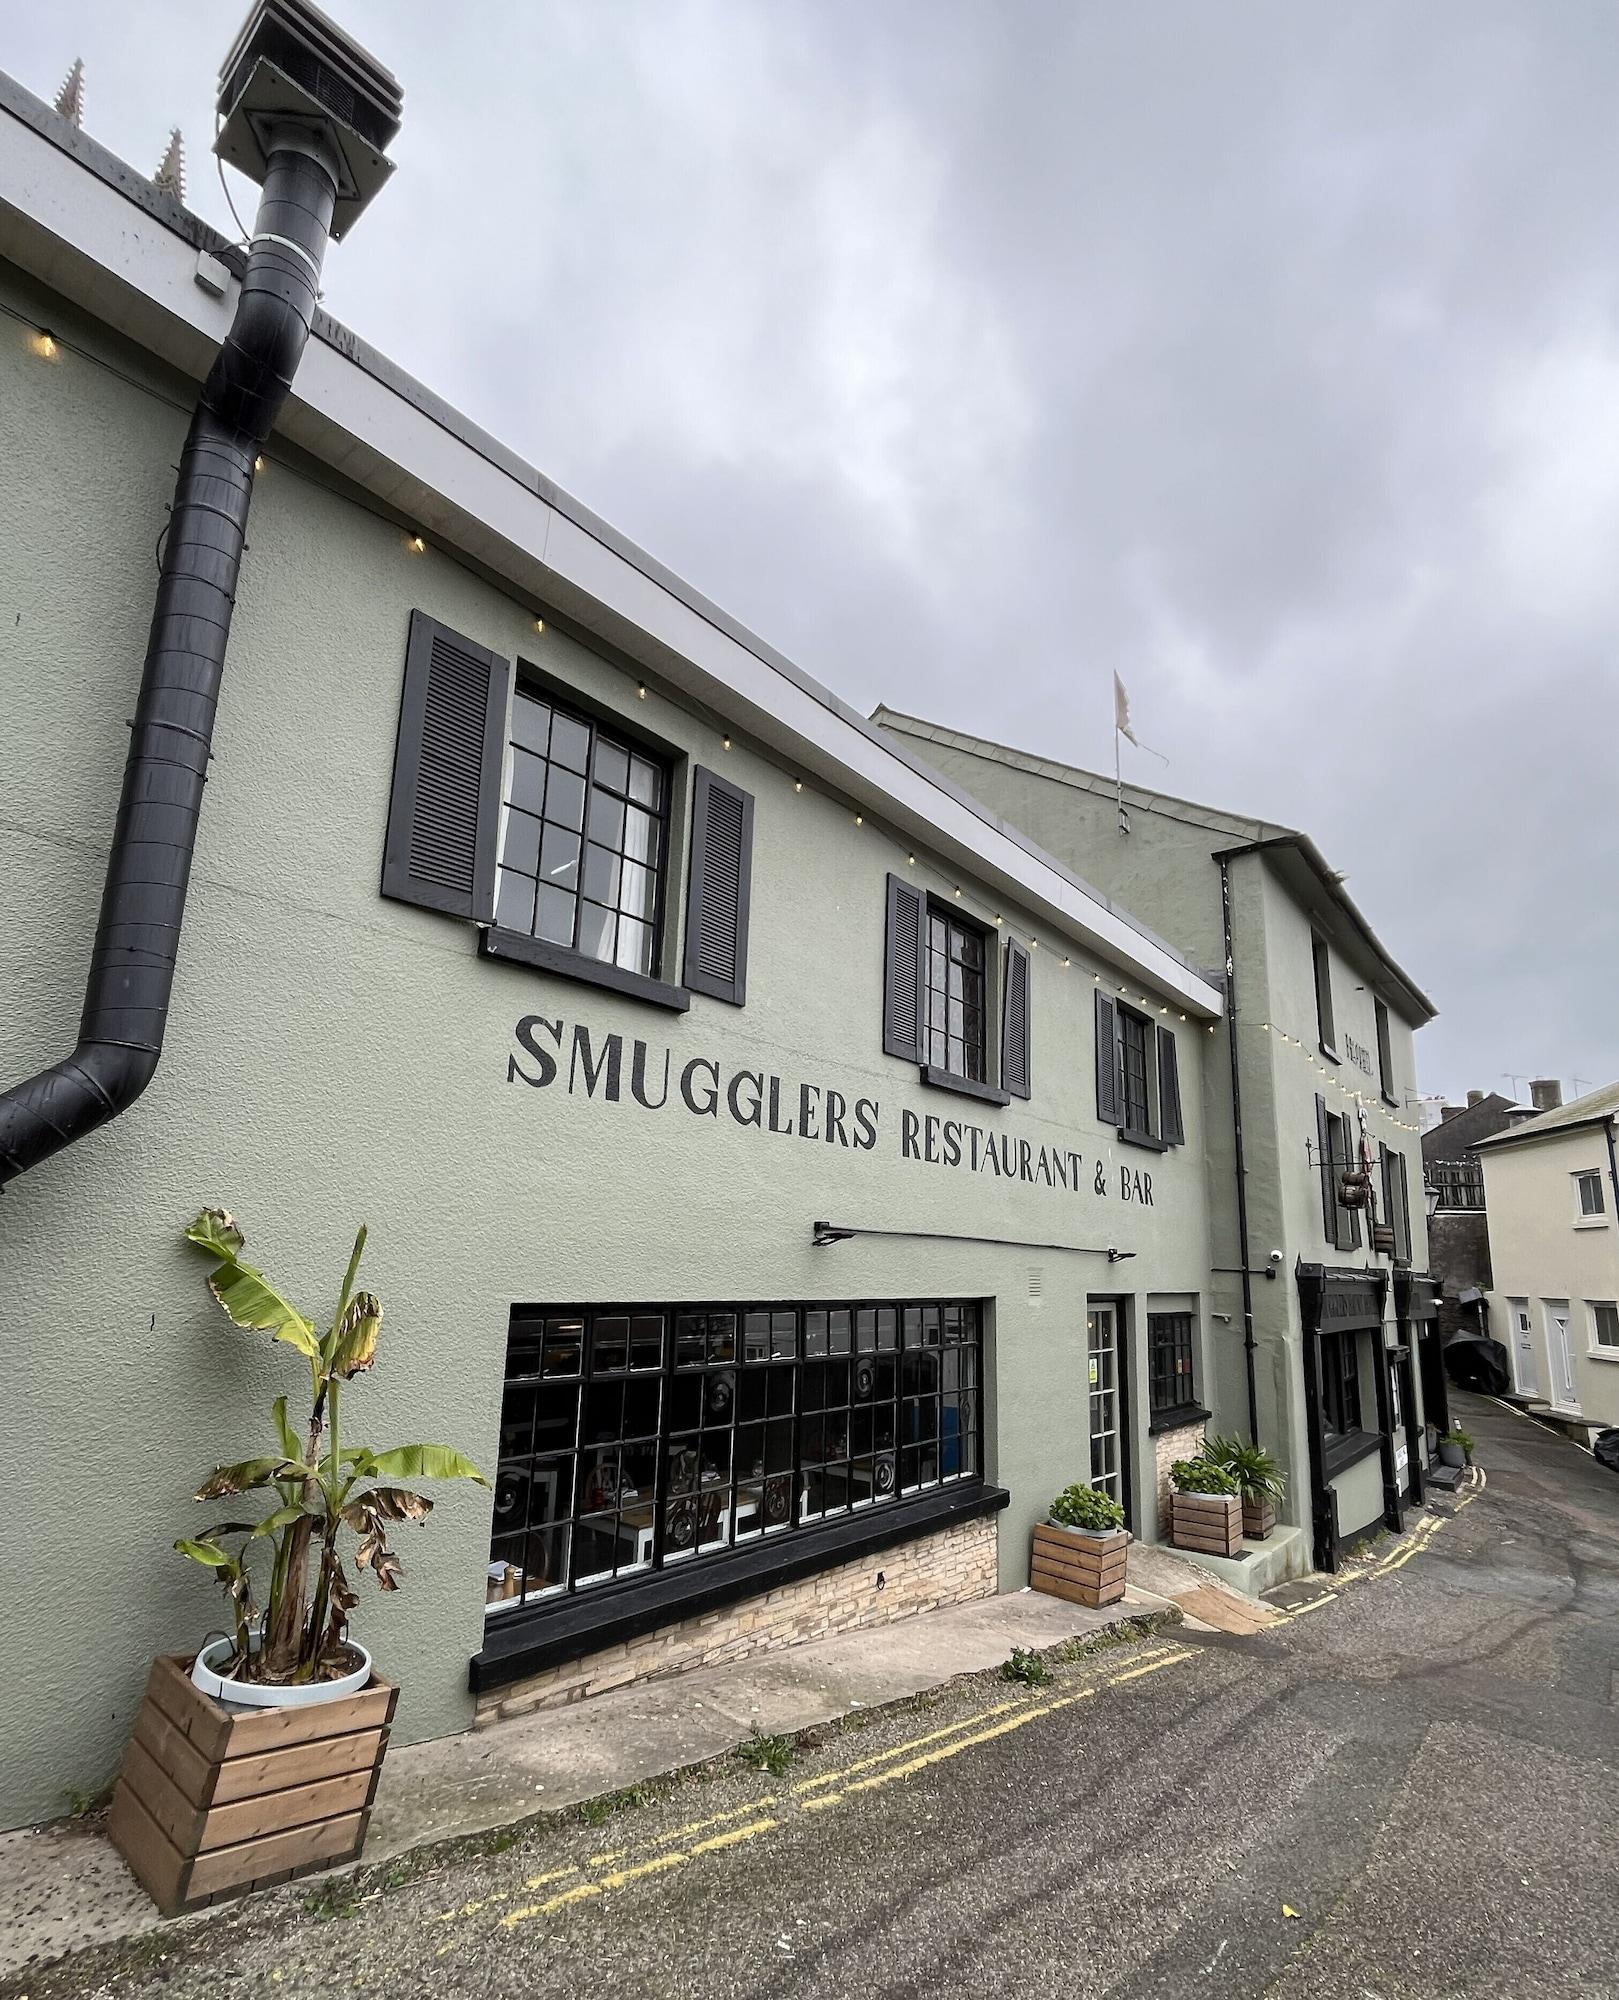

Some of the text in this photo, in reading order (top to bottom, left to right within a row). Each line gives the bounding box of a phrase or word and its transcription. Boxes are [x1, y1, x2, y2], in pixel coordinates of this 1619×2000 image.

[507, 1015, 1154, 1206] SMUGGLERS RESTAURANT & BAR
